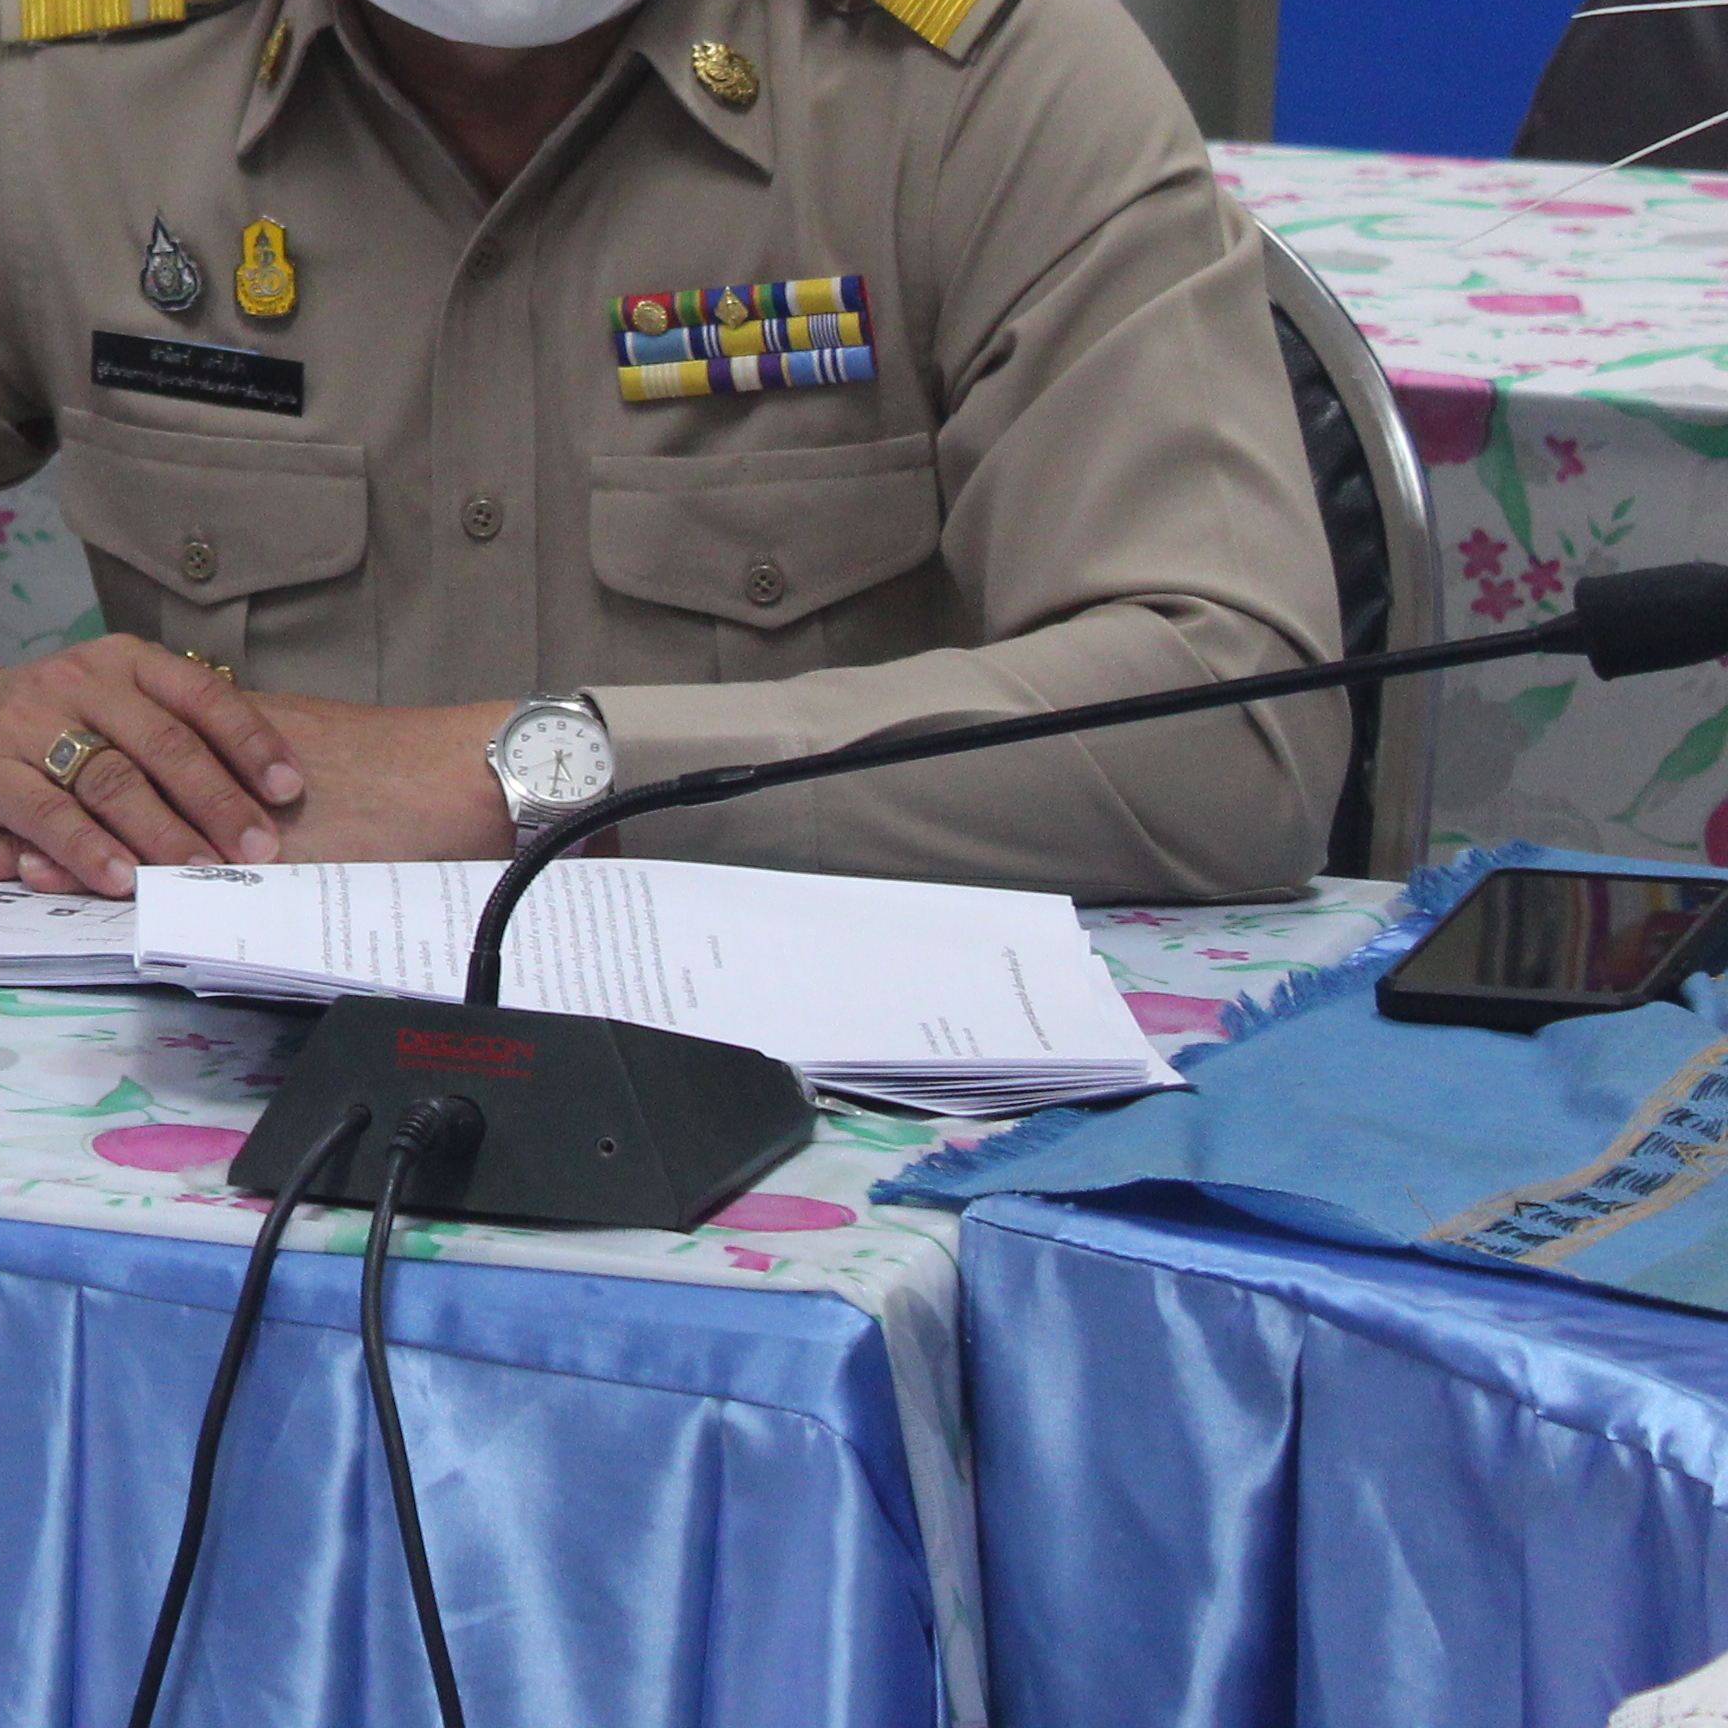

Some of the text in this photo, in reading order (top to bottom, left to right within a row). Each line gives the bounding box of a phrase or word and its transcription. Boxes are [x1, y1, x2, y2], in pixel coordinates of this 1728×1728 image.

[520, 733, 531, 742] 4
[576, 728, 585, 738] 7
[512, 748, 523, 759] 3
[517, 765, 528, 776] 2
[570, 787, 582, 797] 11
